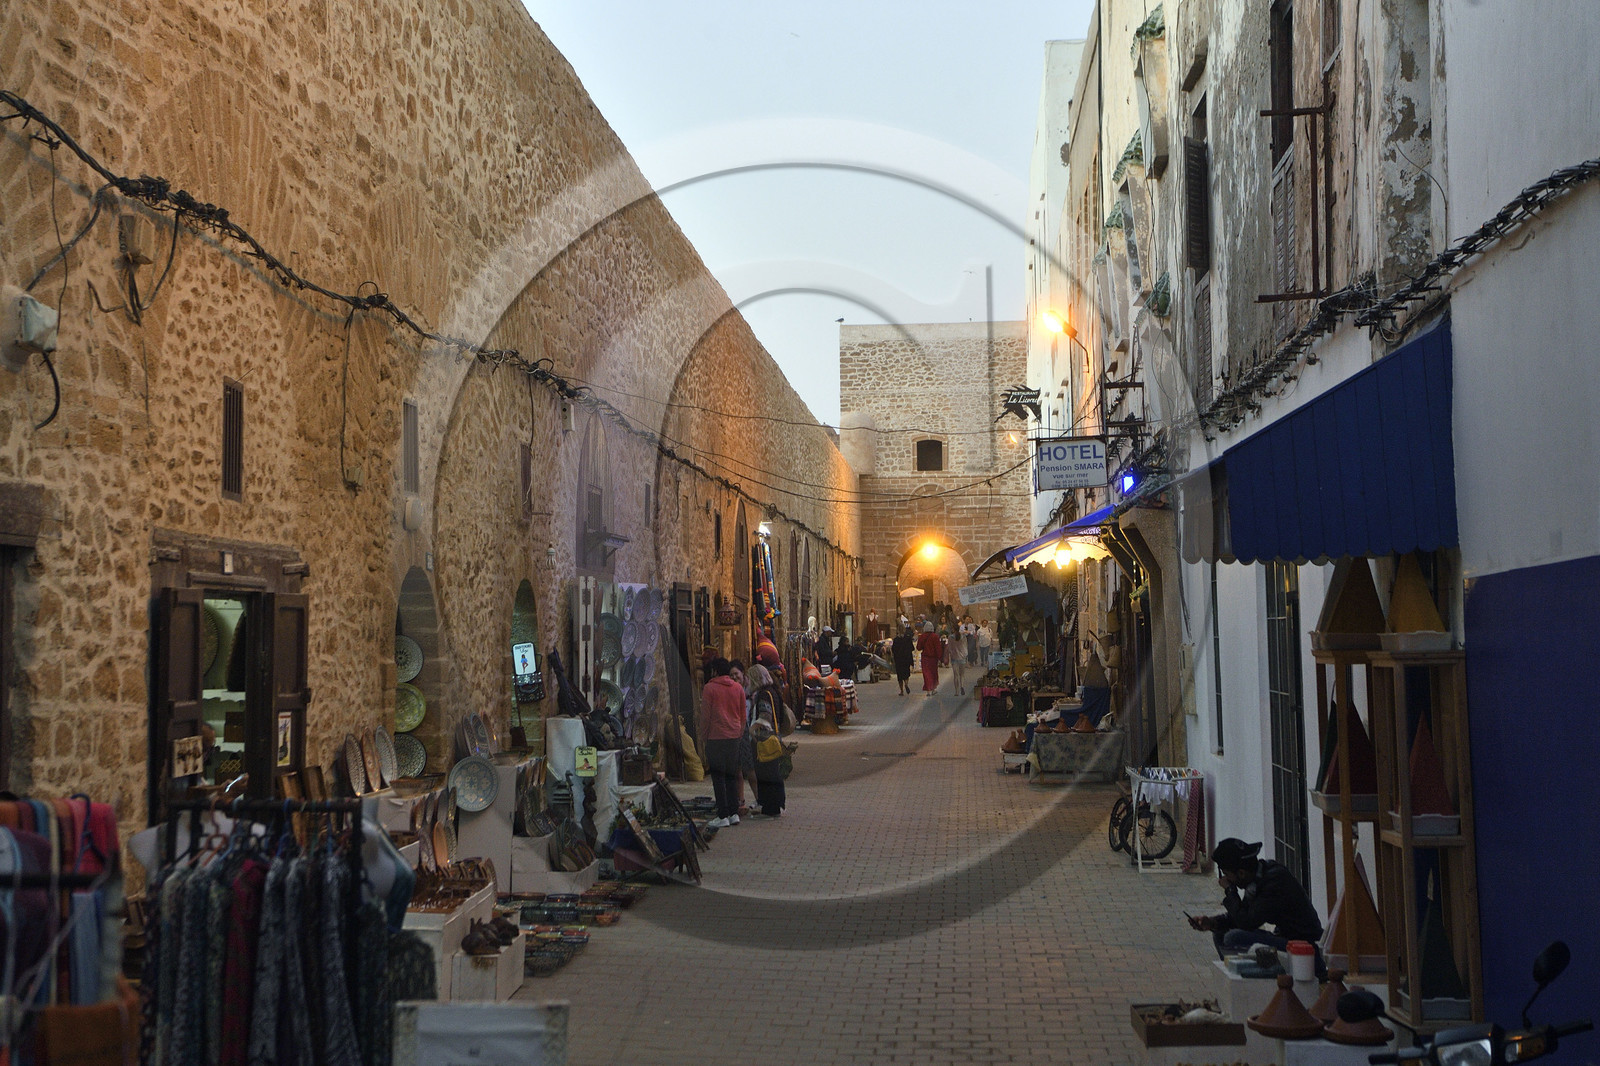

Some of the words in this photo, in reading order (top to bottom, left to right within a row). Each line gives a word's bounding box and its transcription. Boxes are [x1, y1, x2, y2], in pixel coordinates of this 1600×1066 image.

[1039, 445, 1104, 461] HOTEL
[1040, 464, 1072, 472] Pension
[1074, 462, 1104, 470] SMARA
